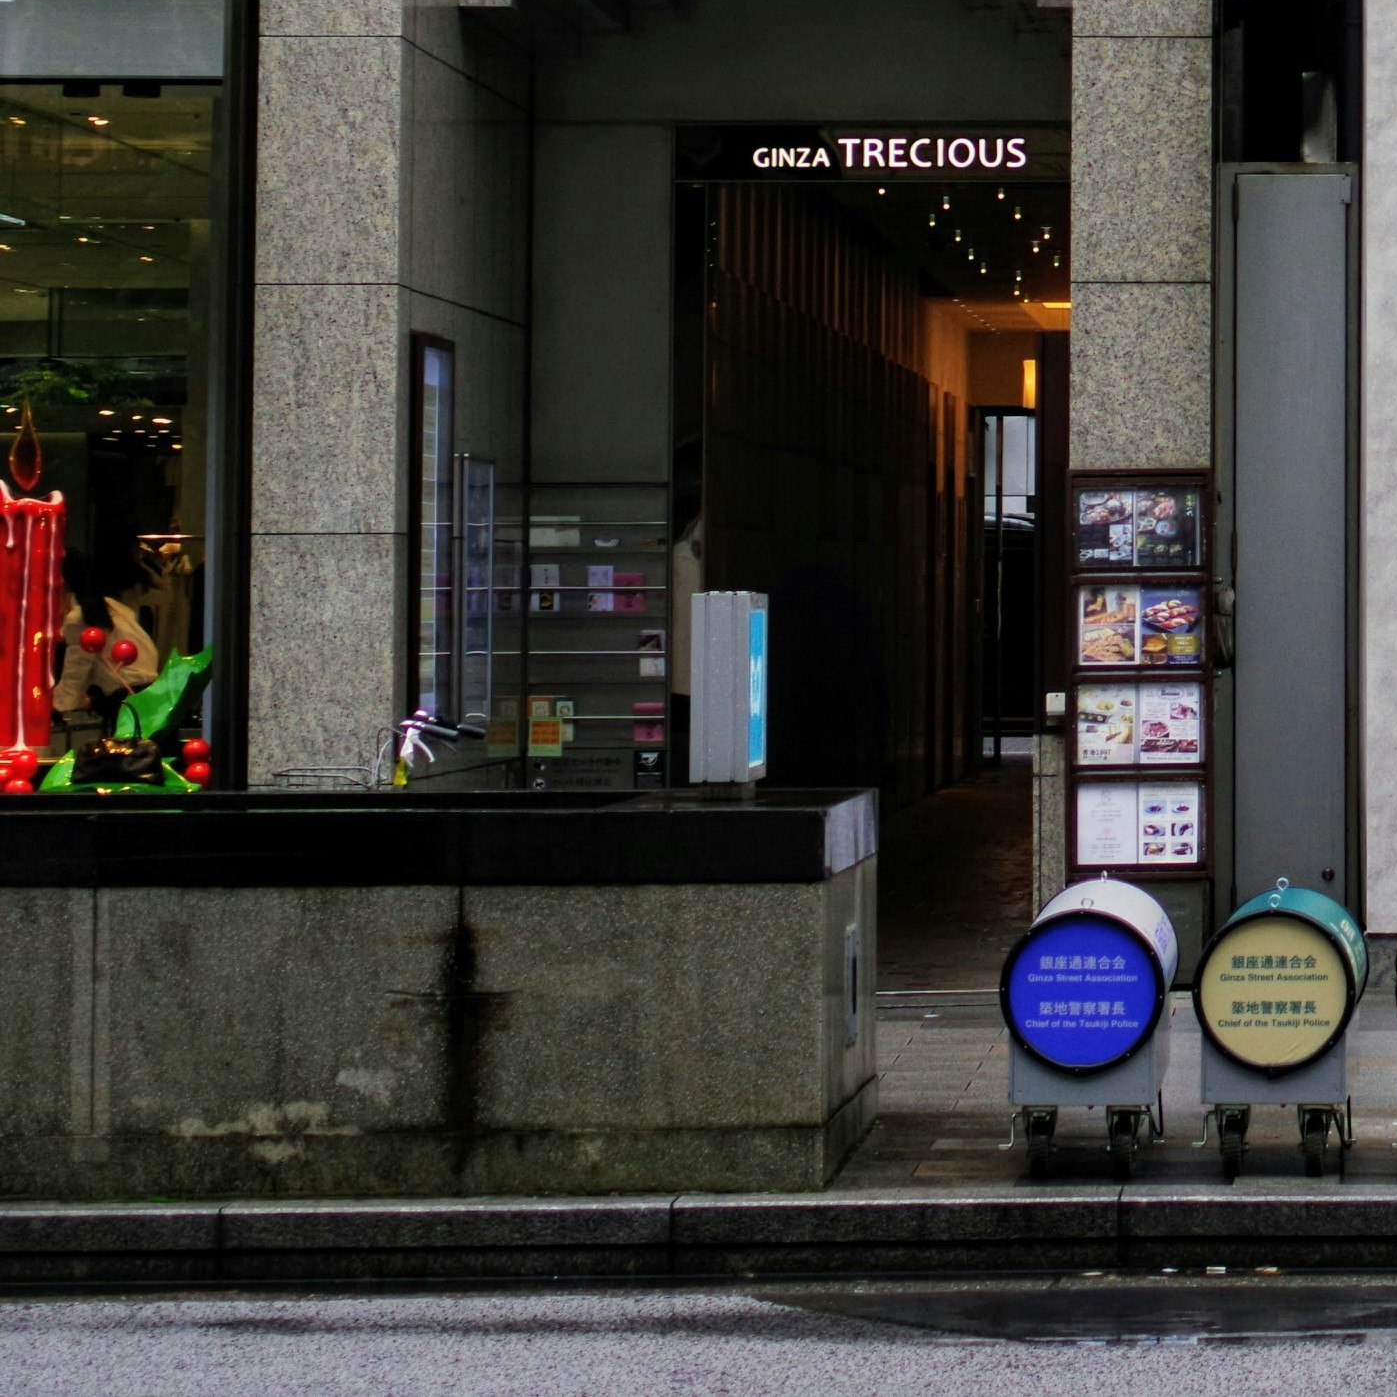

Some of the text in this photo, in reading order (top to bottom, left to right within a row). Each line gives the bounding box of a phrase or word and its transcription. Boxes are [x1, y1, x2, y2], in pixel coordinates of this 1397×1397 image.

[753, 147, 830, 168] GINZA
[838, 137, 1026, 168] TRECIOUS
[1040, 955, 1126, 970] 銀座通連合会
[1232, 955, 1317, 969] 銀座通連合会
[1028, 973, 1137, 982] Ginza Street Association
[1220, 973, 1328, 982] Ginza Street Association
[1039, 1001, 1126, 1016] 築地警察署長
[1231, 1000, 1317, 1015] 築地警察署長
[1025, 1019, 1139, 1030] Chief of the Tsukiji Police
[1218, 1018, 1330, 1029] Chief of the Tsukiji Police
